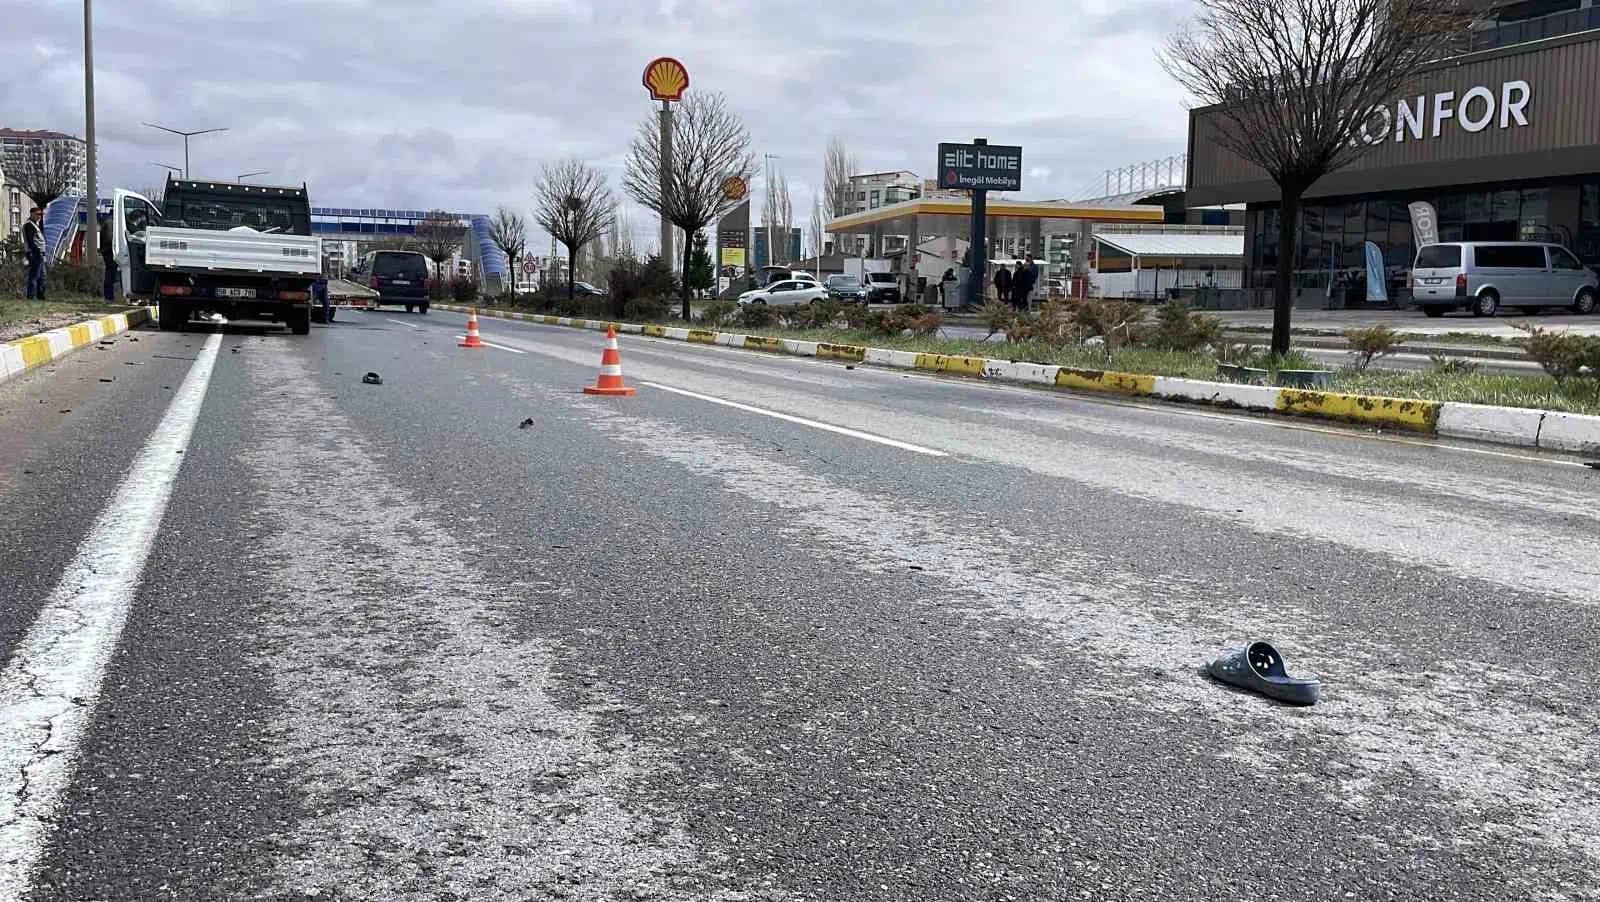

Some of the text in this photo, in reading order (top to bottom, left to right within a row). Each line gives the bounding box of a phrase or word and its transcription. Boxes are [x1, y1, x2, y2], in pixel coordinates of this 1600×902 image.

[945, 149, 1018, 170] elit home
[960, 174, 1016, 187] İnegöl Mobilya
